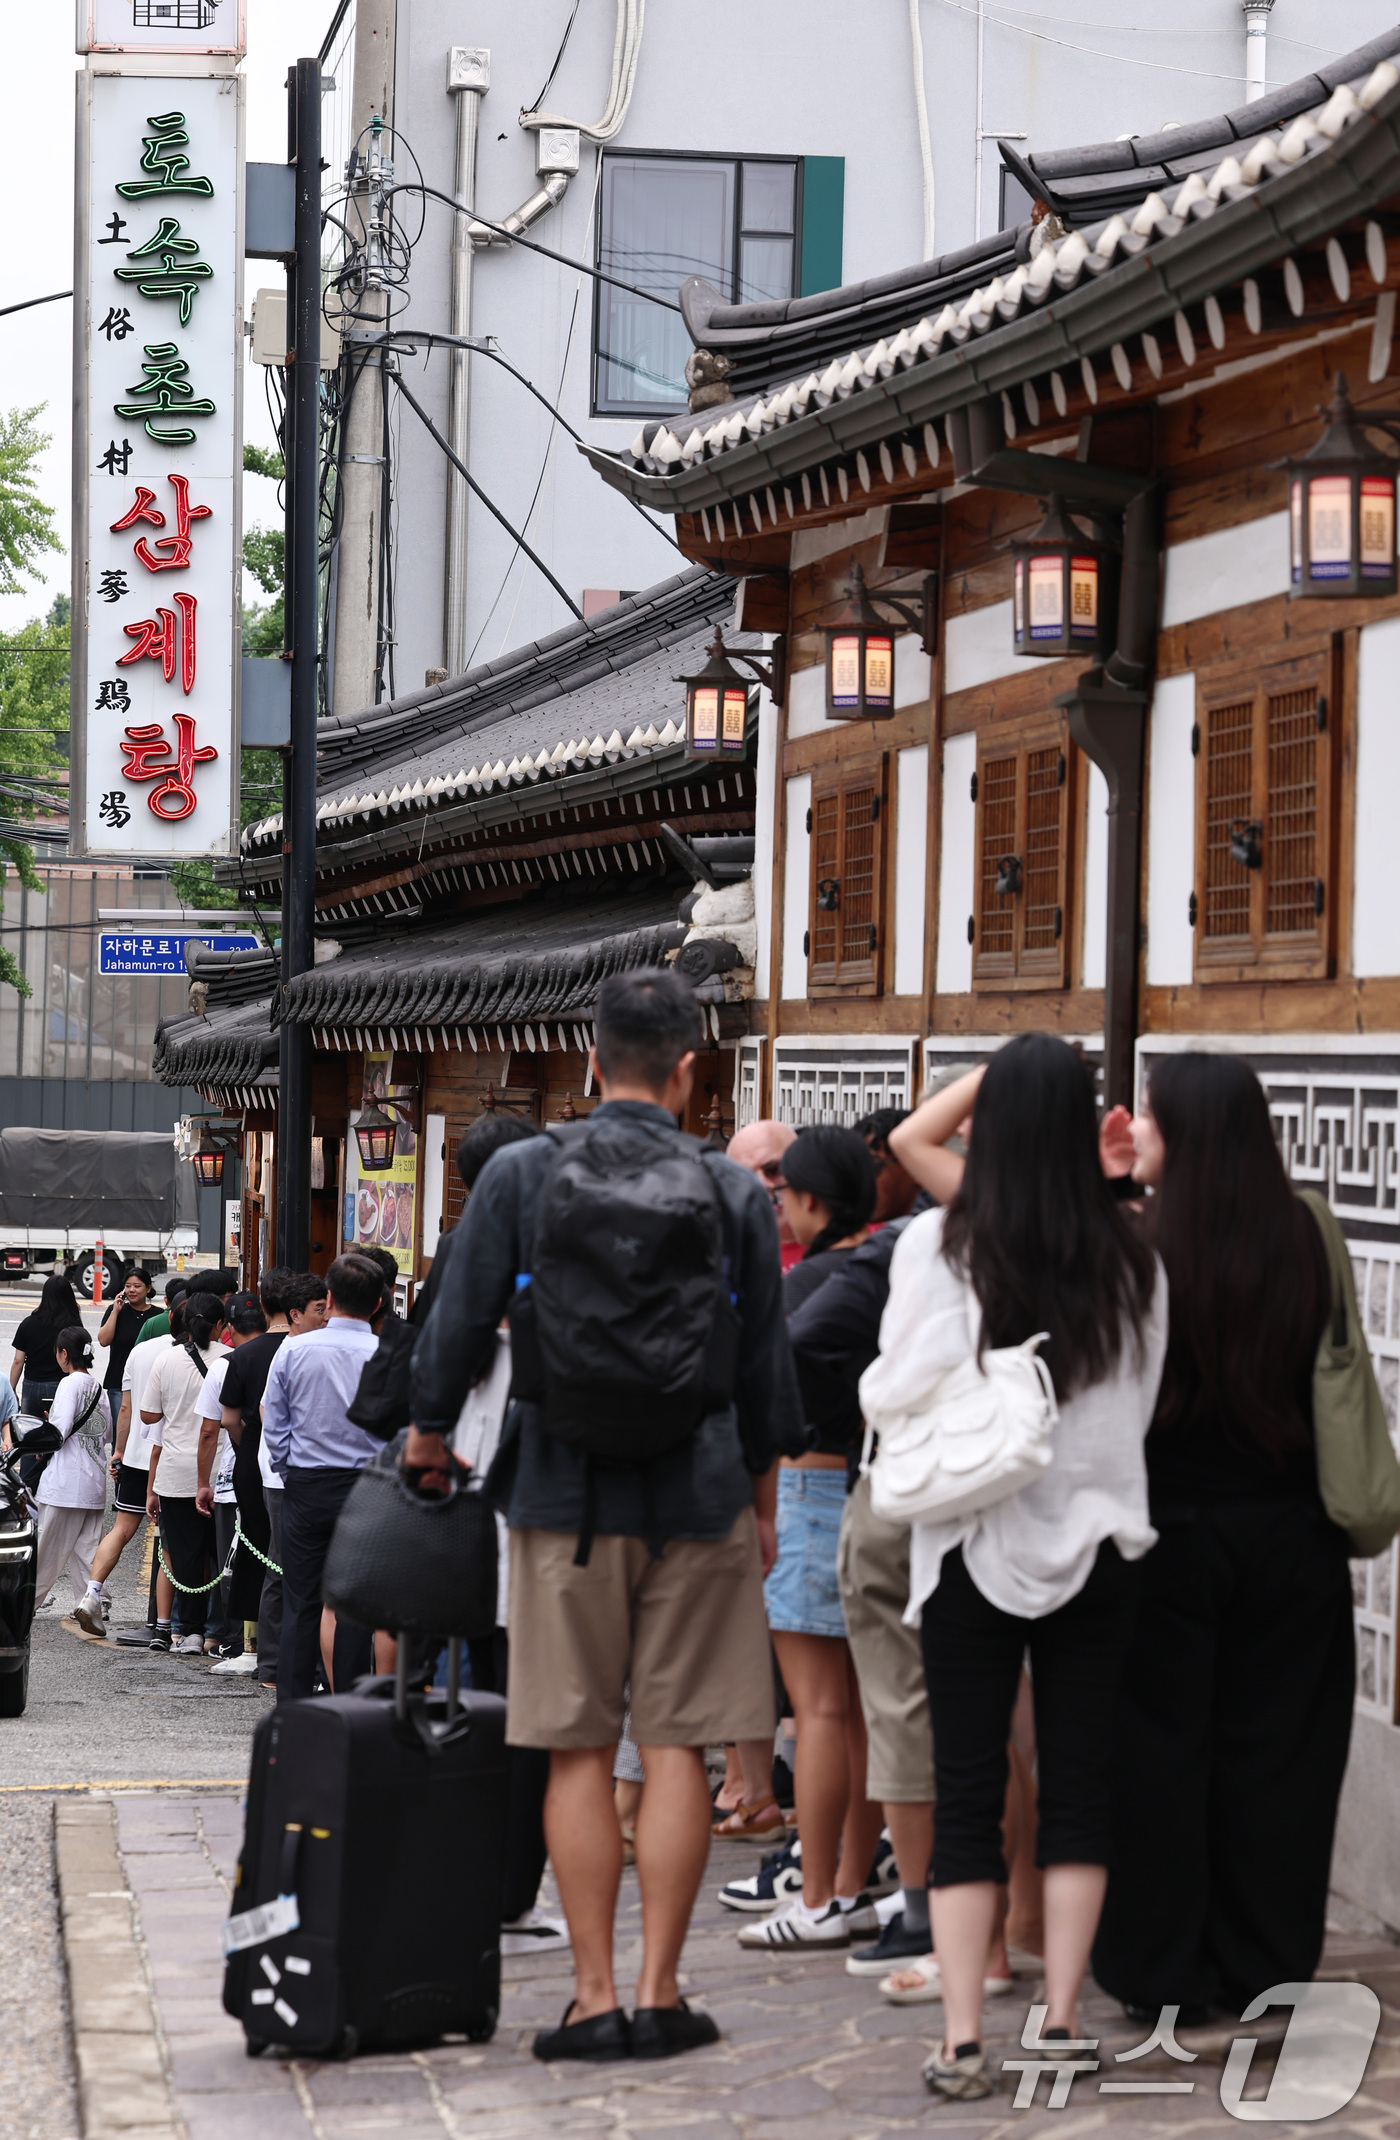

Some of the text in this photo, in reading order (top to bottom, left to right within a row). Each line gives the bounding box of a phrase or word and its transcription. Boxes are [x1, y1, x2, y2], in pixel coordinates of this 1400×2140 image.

[105, 938, 214, 957] 자하문로1
[105, 959, 189, 973] Jahamun-ro 1
